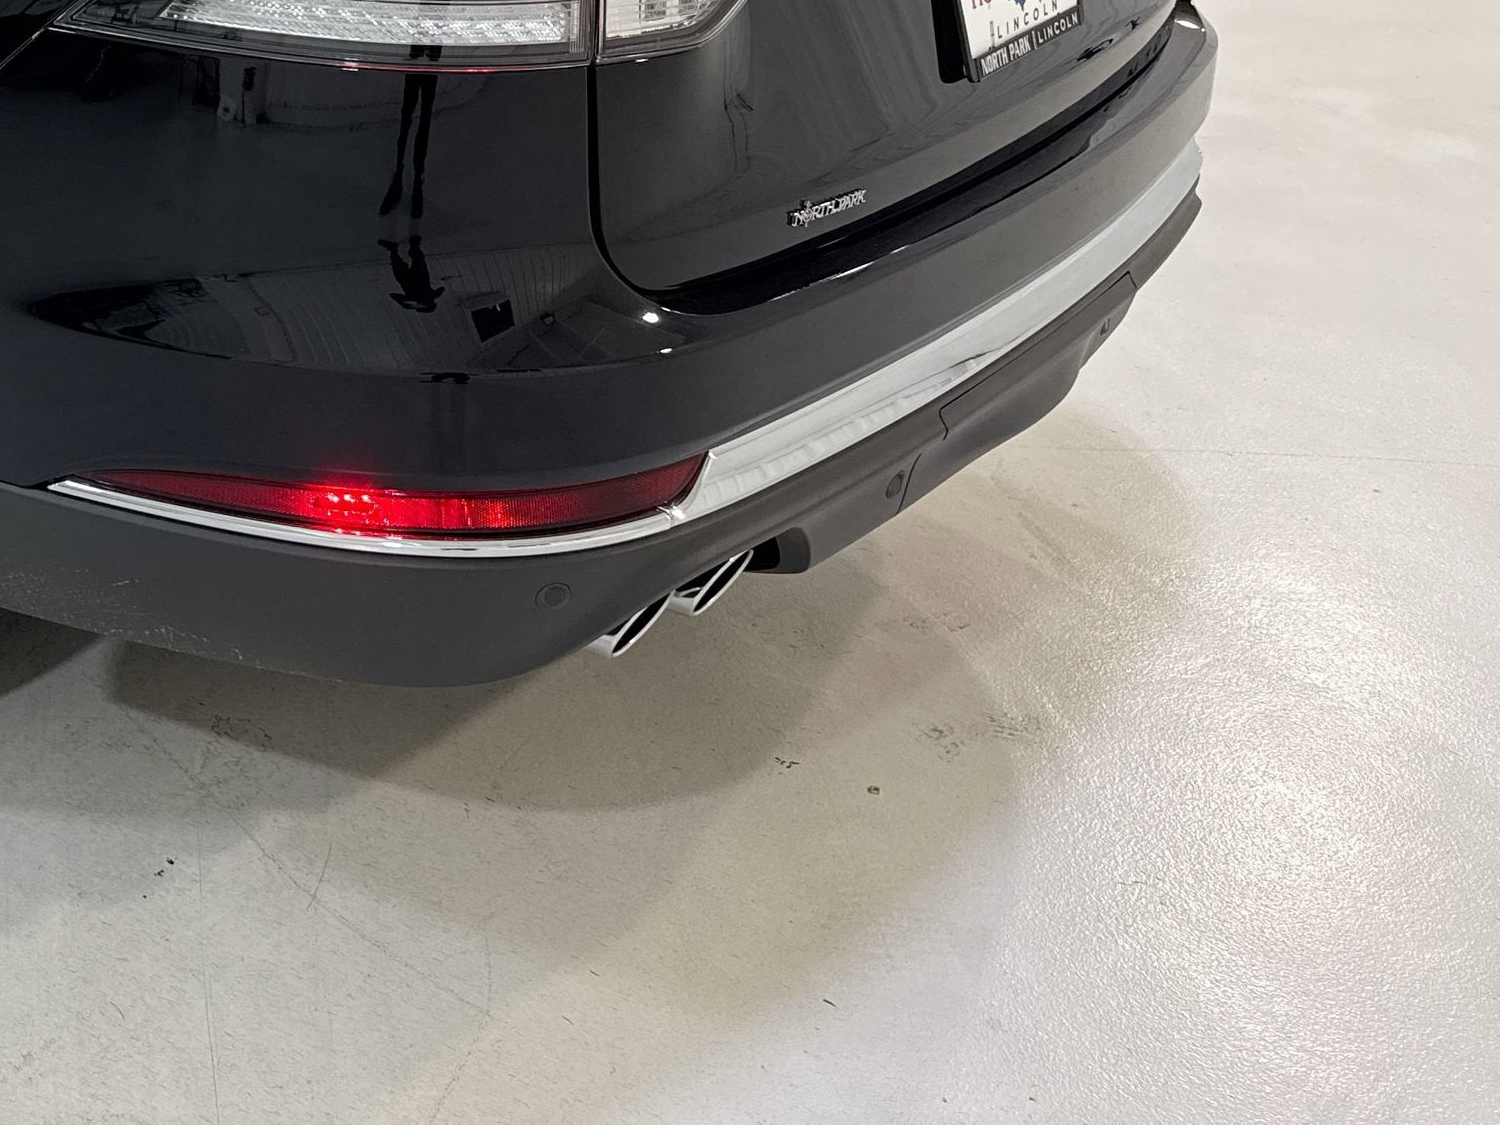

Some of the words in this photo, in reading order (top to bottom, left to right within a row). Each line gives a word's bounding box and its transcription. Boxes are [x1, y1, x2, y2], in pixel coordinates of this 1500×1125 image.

[981, 47, 1009, 75] NORTH
[1008, 34, 1031, 61] PARK
[1037, 12, 1078, 44] LINCOLN
[791, 202, 836, 228] NORTH
[834, 189, 867, 212] PARK
